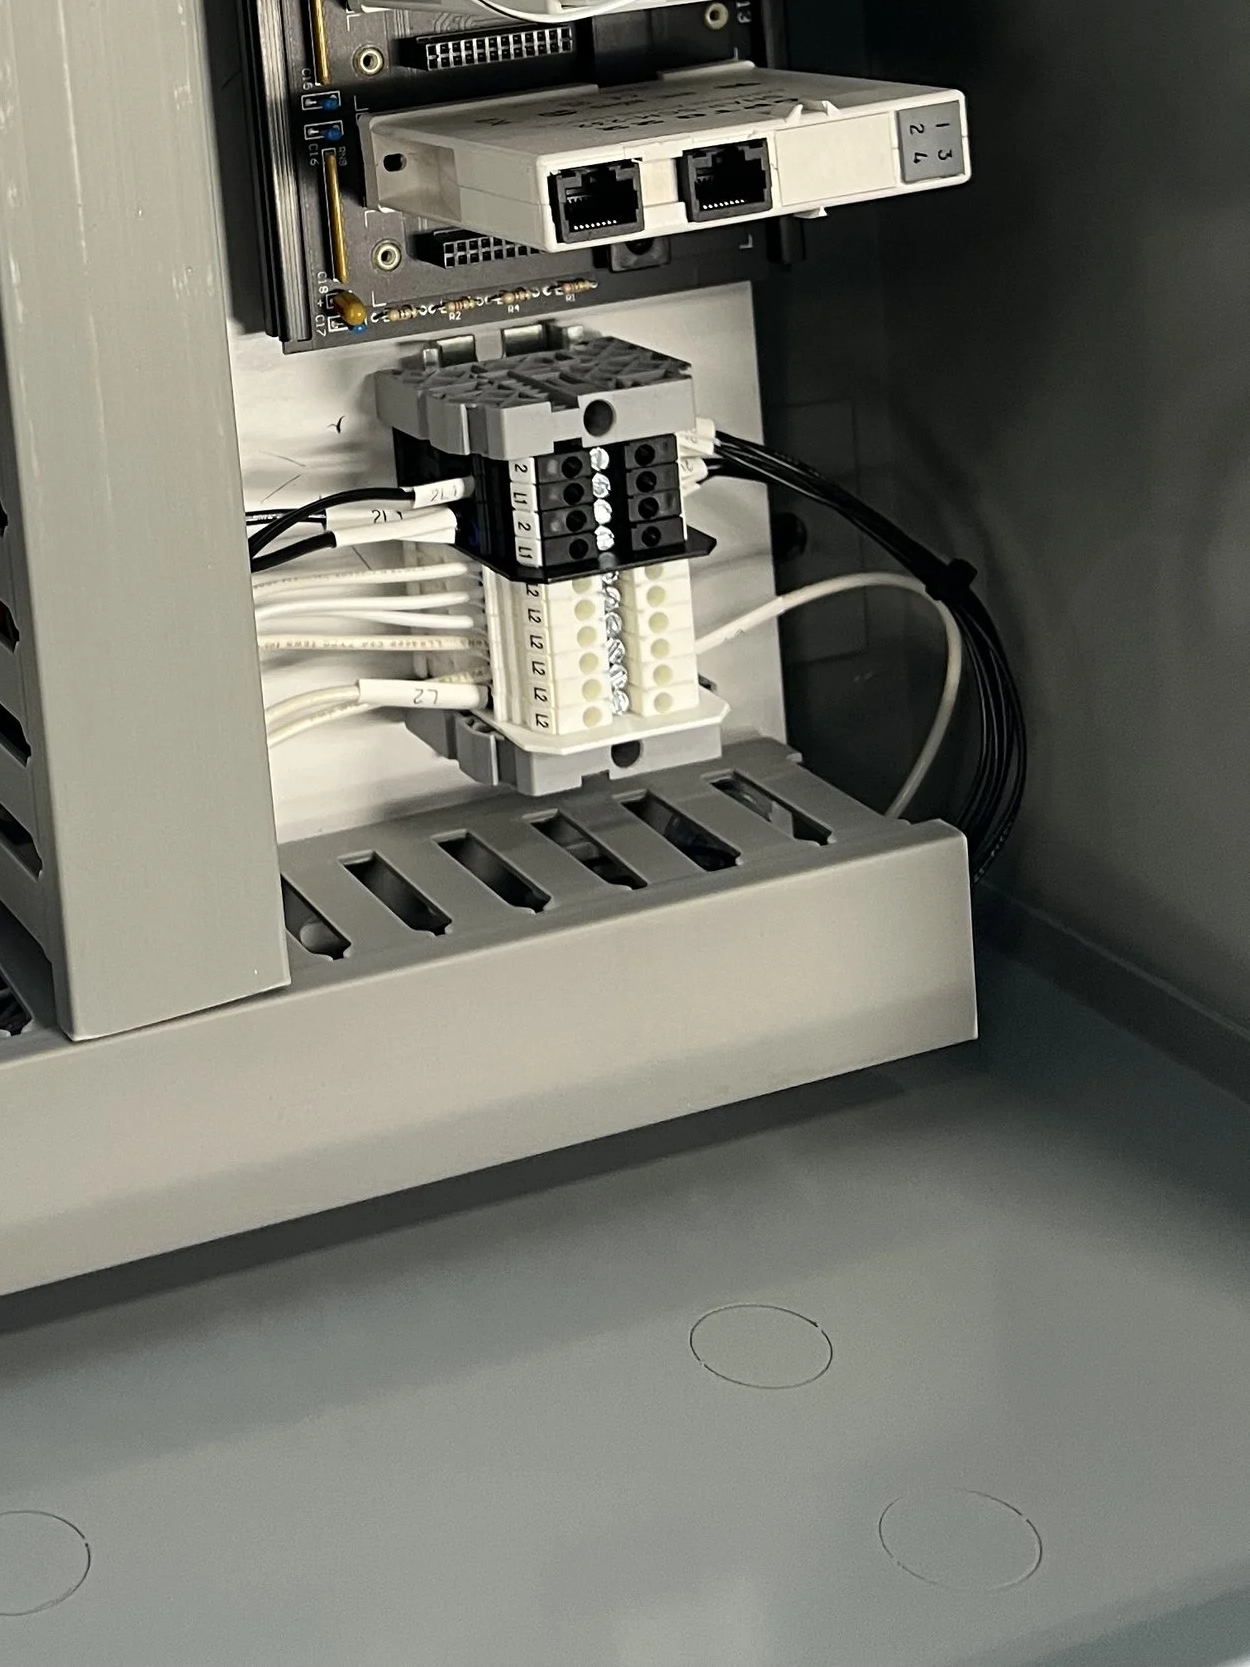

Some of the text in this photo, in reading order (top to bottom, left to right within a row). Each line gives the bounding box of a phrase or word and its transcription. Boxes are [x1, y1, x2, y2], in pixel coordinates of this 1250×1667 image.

[736, 0, 751, 24] 13
[301, 67, 313, 91] C15
[909, 123, 928, 164] 2 4
[308, 142, 319, 167] C16
[938, 149, 953, 161] 3
[317, 271, 328, 294] C18
[565, 293, 576, 302] R1
[449, 312, 462, 321] R2
[507, 304, 520, 313] R4
[315, 315, 327, 337] C17
[514, 463, 528, 473] 2
[513, 491, 528, 505] L1
[518, 521, 531, 531] 2
[518, 545, 533, 559] L1
[525, 583, 539, 598] L2
[528, 608, 542, 624] L2
[529, 634, 544, 650] L2
[531, 660, 546, 676] L2
[413, 688, 439, 705] L2
[533, 687, 548, 702] L2
[535, 713, 549, 729] L2
